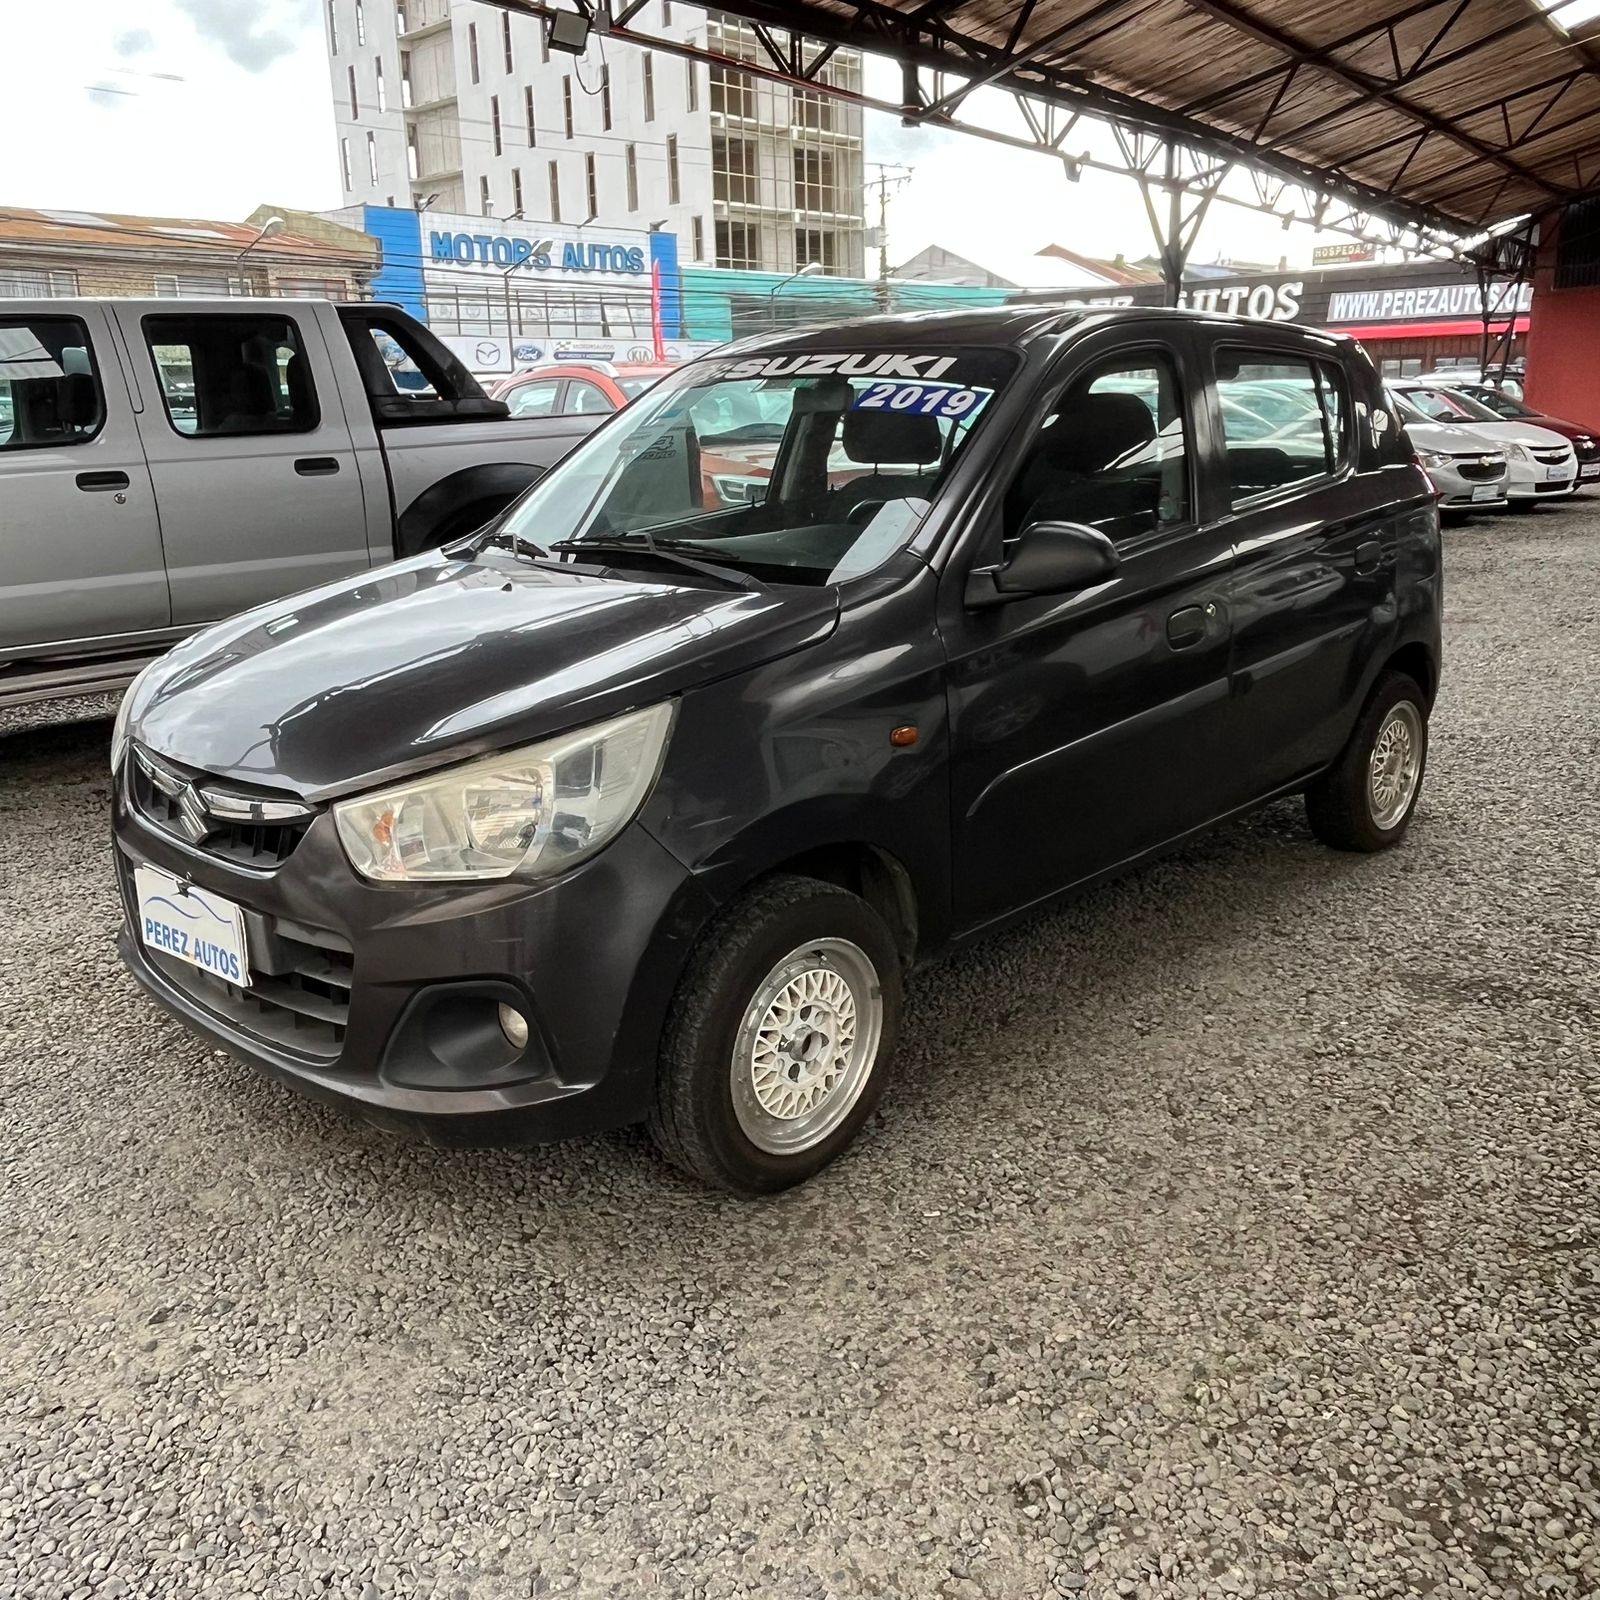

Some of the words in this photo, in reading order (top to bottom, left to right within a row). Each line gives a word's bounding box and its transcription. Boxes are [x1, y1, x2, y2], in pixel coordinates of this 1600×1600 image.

[561, 242, 645, 275] AUTOS
[724, 354, 957, 379] SUZUKI
[858, 383, 978, 416] 2019
[145, 917, 190, 957] PEREZ
[194, 937, 240, 980] AUTOS
